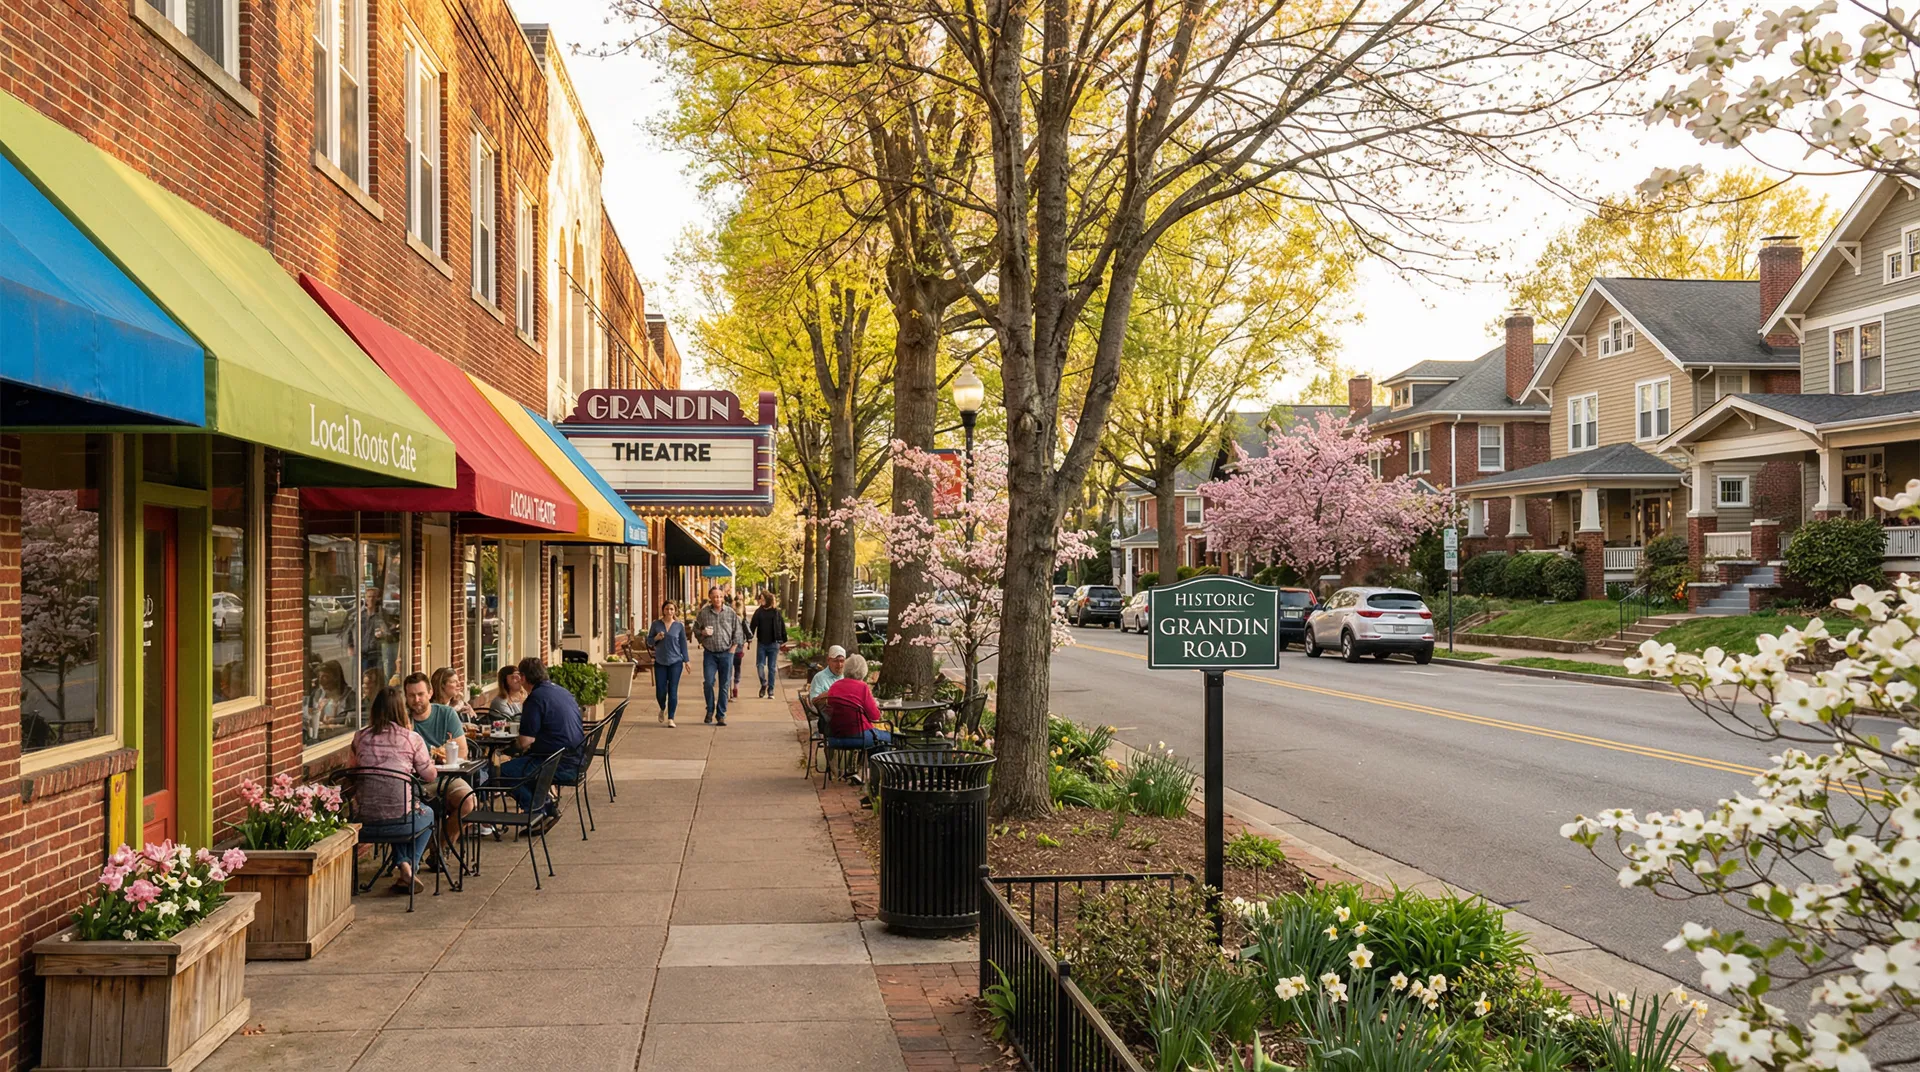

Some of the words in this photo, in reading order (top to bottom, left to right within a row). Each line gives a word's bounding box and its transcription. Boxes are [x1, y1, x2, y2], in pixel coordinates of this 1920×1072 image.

[587, 395, 729, 421] GRANDIN
[309, 403, 350, 455] Local
[352, 418, 389, 466] Roots
[391, 432, 417, 472] Cafe
[612, 442, 711, 462] THEATRE
[1175, 593, 1255, 607] HISTORIC
[1159, 617, 1270, 636] GRANDIN
[1182, 640, 1247, 658] ROAD
